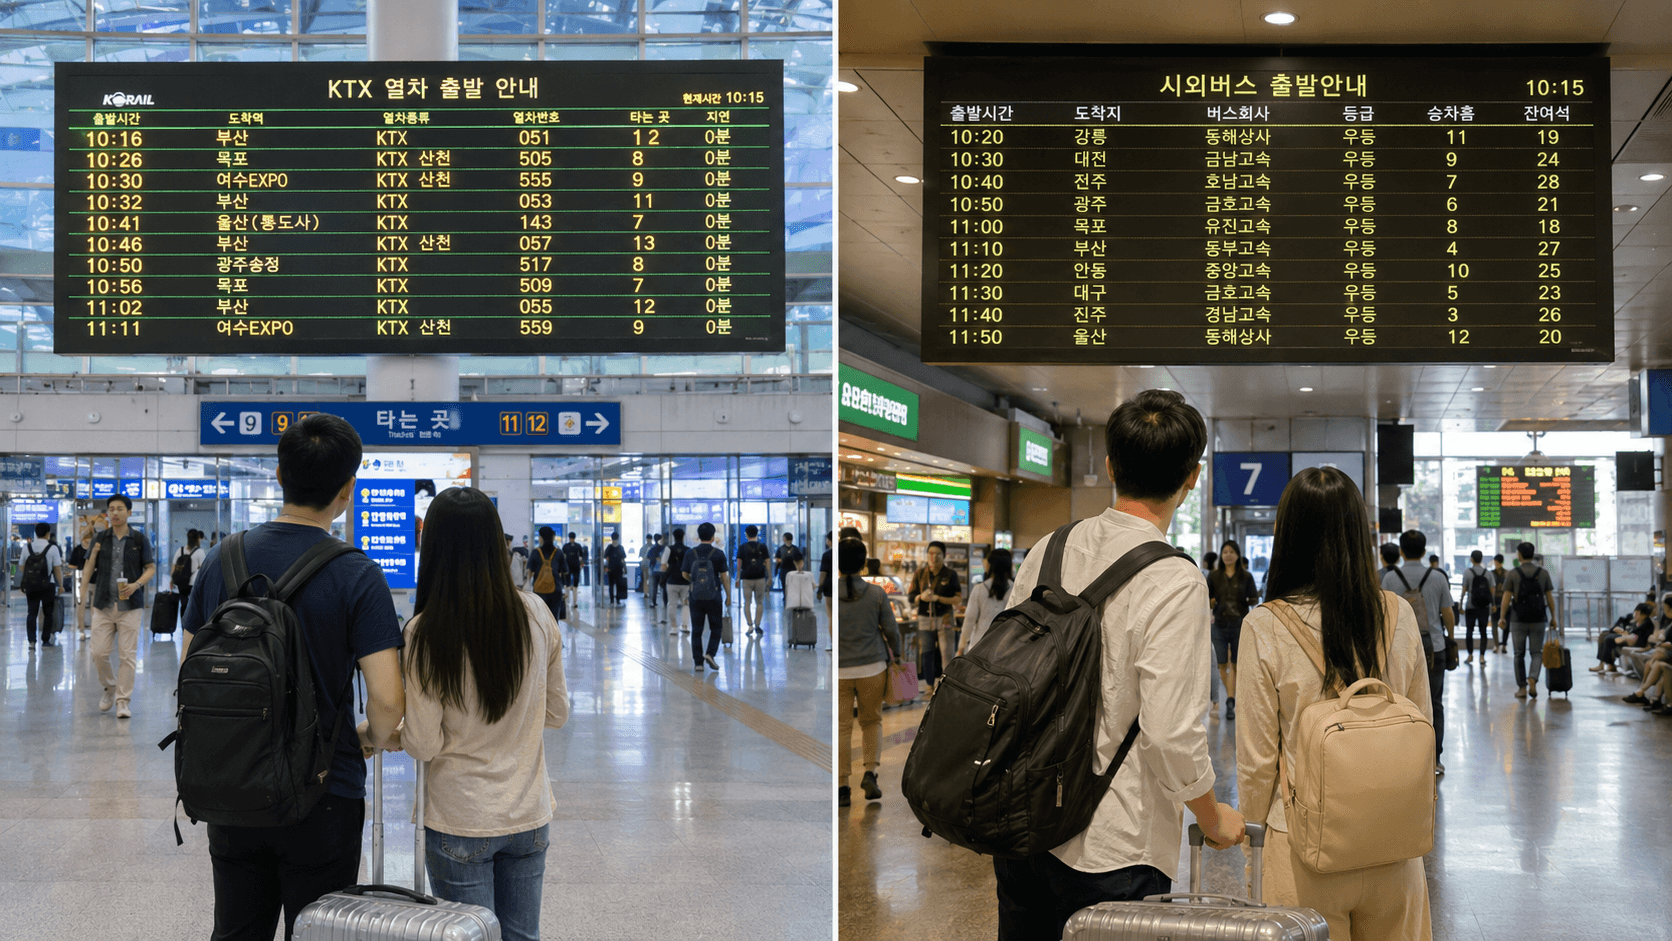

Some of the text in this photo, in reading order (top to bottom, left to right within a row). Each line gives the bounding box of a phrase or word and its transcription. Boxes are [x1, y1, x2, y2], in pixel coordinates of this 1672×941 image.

[328, 77, 538, 100] KTX 열차 출발 안내
[1159, 74, 1367, 98] 시외버스 출발안내
[1526, 80, 1584, 96] 10:15
[102, 92, 155, 108] KORAIL
[682, 92, 765, 105] 현재시간 10:15
[92, 113, 141, 126] 출발시간
[228, 112, 264, 126] 도착역
[512, 111, 561, 125] 열차번호
[630, 111, 654, 124] 타는
[657, 111, 671, 124] 곳
[706, 110, 730, 124] 지연
[950, 105, 1570, 122] 출발시간 도착지 버스회사 등급 승차홈 잔여석
[86, 131, 143, 148] 10:16
[215, 130, 249, 147] 부산
[376, 131, 408, 146] KTX
[518, 130, 549, 146] 051
[951, 128, 1559, 146] 10:20 강릉 동해상사 우등 11 19
[86, 152, 143, 169] 10:26
[216, 152, 249, 168] 목포
[376, 152, 409, 167] KTX
[418, 150, 451, 167] 산천
[519, 151, 552, 167] 505
[632, 151, 644, 167] 8
[951, 151, 1560, 168] 10:30 대전 금남고속 우등 9 24
[86, 173, 143, 190] 10:30
[216, 172, 288, 189] 여수EXPO
[376, 173, 409, 188] KTX
[418, 171, 451, 188] 산천
[519, 172, 552, 188] 555
[632, 172, 644, 188] 9
[950, 173, 1560, 191] 10:40 전주 호남고속 우등 7 28
[86, 194, 143, 211] 10:32
[216, 193, 249, 211] 부산
[376, 194, 409, 209] KTX
[519, 194, 553, 209] 053
[633, 193, 652, 209] 11
[950, 196, 1557, 213] 10:50 광주 금호고속 우등 6 21
[86, 216, 140, 232] 10:41
[376, 215, 409, 231] KTX
[520, 215, 553, 230] 143
[632, 215, 644, 230] 7
[950, 219, 1561, 235] 11:00 목포 유진고속 우등 8 18
[86, 237, 143, 253] 10:46
[216, 236, 249, 253] 부산
[376, 236, 409, 252] KTX
[418, 235, 451, 252] 산천
[519, 236, 553, 251] 057
[633, 235, 656, 251] 13
[950, 240, 1561, 258] 11:10 부산 동부고속 우등 4 27
[86, 258, 143, 274] 10:50
[216, 257, 279, 274] 광주송정
[377, 257, 409, 273] KTX
[519, 257, 553, 272] 517
[632, 257, 645, 272] 8
[950, 263, 1561, 280] 11:20 안동 중앙고속 우등 10 25
[86, 279, 143, 295] 10:56
[216, 278, 249, 294] 목포
[377, 278, 409, 294] KTX
[519, 278, 553, 293] 509
[632, 278, 644, 293] 7
[949, 285, 1561, 302] 11:30 대구 금호고속 우등 5 23
[86, 300, 143, 316] 11:02
[216, 299, 249, 316] 부산
[377, 299, 409, 315] KTX
[519, 299, 553, 315] 055
[633, 299, 656, 314] 12
[949, 306, 1562, 324] 11:40 진주 경남고속 우등 3 26
[86, 321, 140, 337] 11:11
[216, 320, 294, 337] 여수EXPO
[377, 320, 409, 336] KTX
[419, 320, 451, 336] 산천
[519, 320, 553, 336] 559
[632, 320, 645, 335] 9
[949, 329, 1562, 346] 11:50 울산 동해상사 우등 12 20
[245, 415, 256, 432] 9
[277, 415, 288, 432] 9
[376, 410, 418, 429] 타는
[502, 414, 546, 432] 11 12
[1240, 463, 1262, 495] 7
